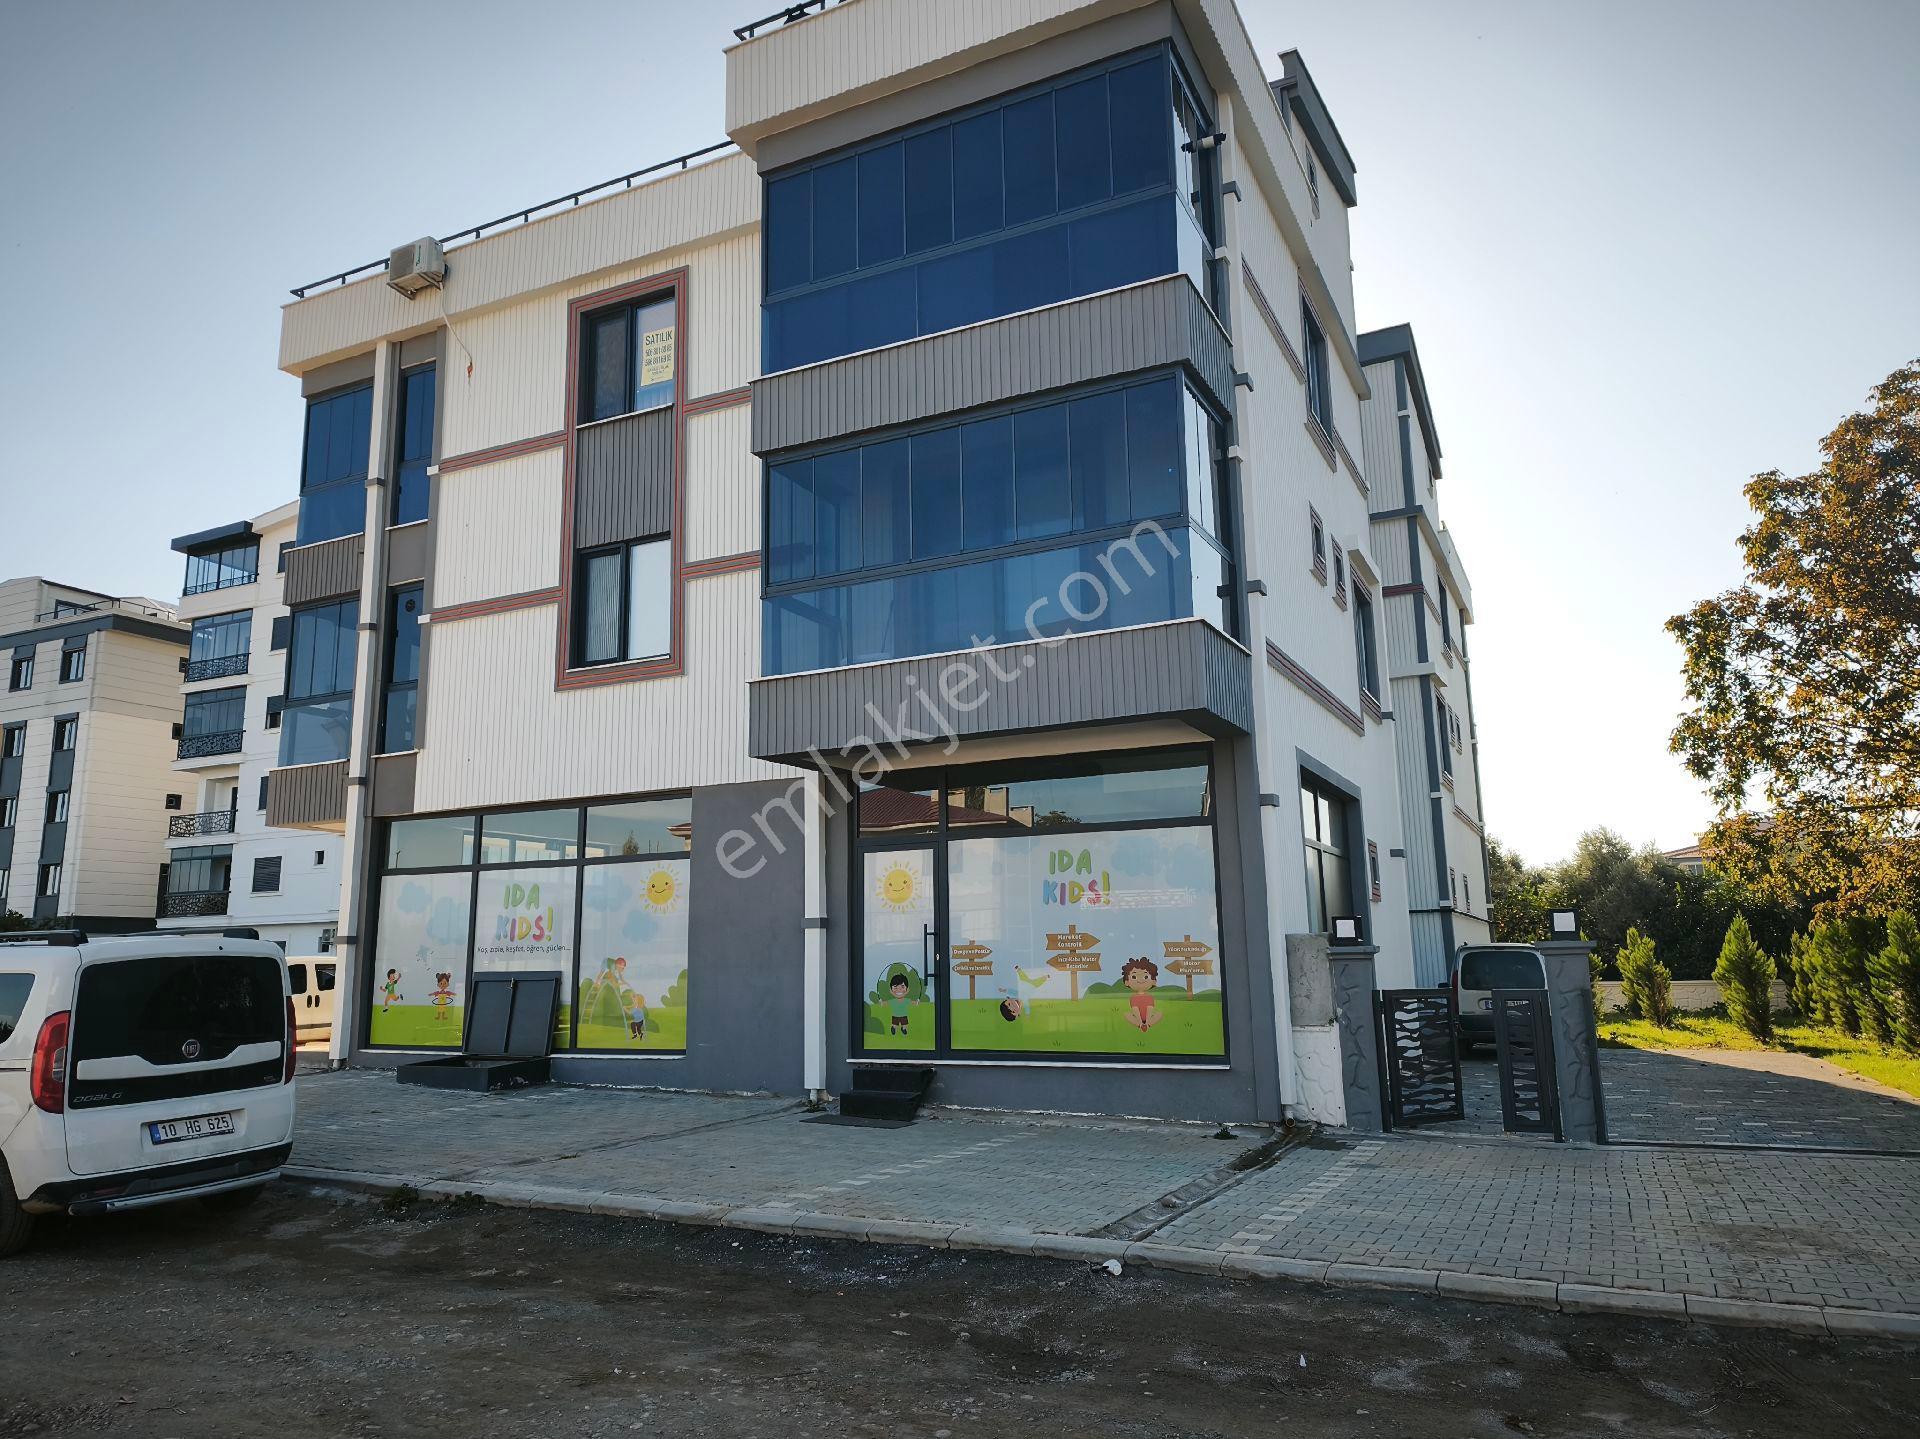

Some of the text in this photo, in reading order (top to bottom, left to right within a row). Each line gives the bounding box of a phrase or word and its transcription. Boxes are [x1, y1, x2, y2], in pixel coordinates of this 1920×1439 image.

[645, 330, 672, 345] SATILIK
[1049, 848, 1092, 875] IDA
[503, 882, 540, 911] IDA
[1042, 870, 1111, 906] KIDS!
[495, 906, 553, 941] KIDS!
[161, 1123, 177, 1138] 10
[185, 1119, 202, 1134] HG
[207, 1115, 230, 1131] 625
